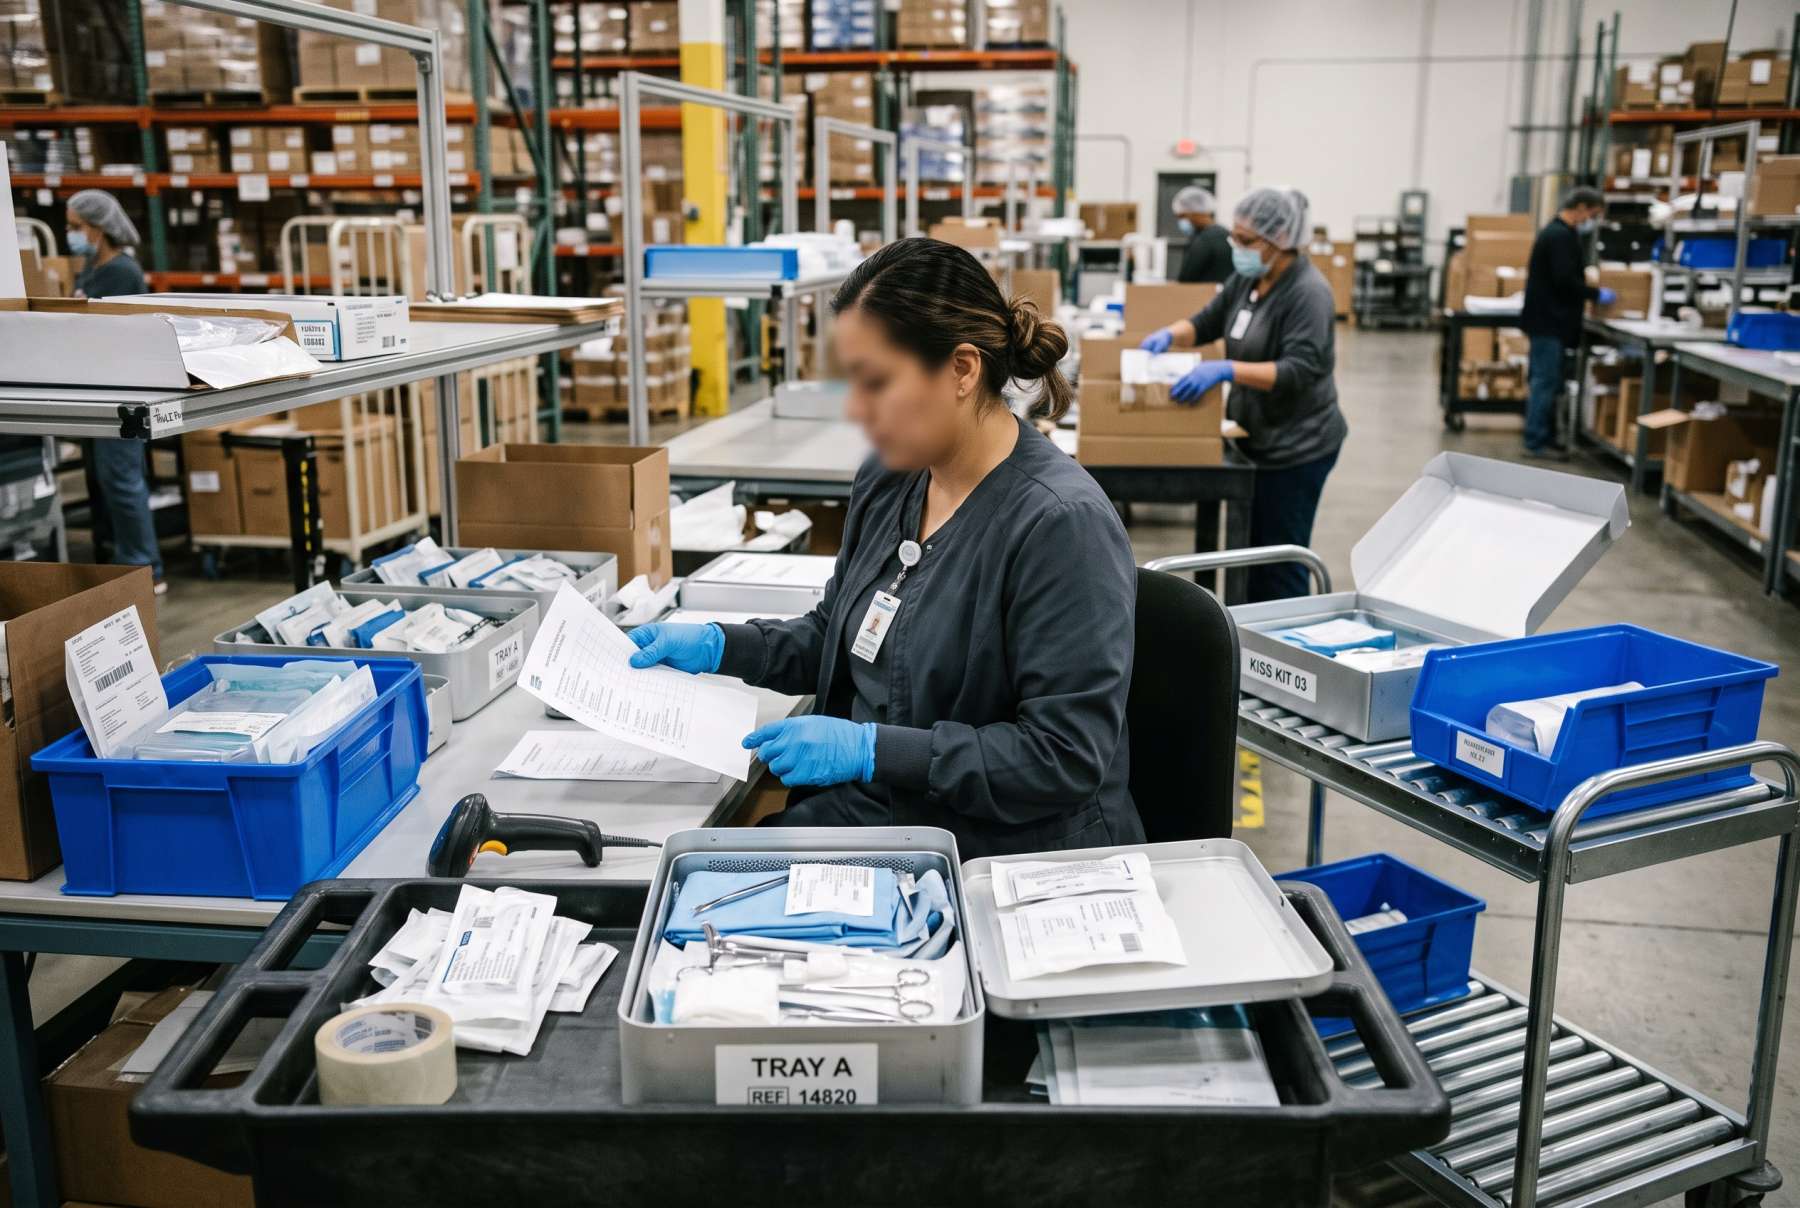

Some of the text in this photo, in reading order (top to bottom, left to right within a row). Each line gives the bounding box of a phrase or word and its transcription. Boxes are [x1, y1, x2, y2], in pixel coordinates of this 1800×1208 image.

[495, 645, 512, 664] TRAY
[1250, 657, 1307, 692] KISS KIT 03
[752, 1057, 853, 1078] TRAY A
[752, 1089, 857, 1105] REF 14820
